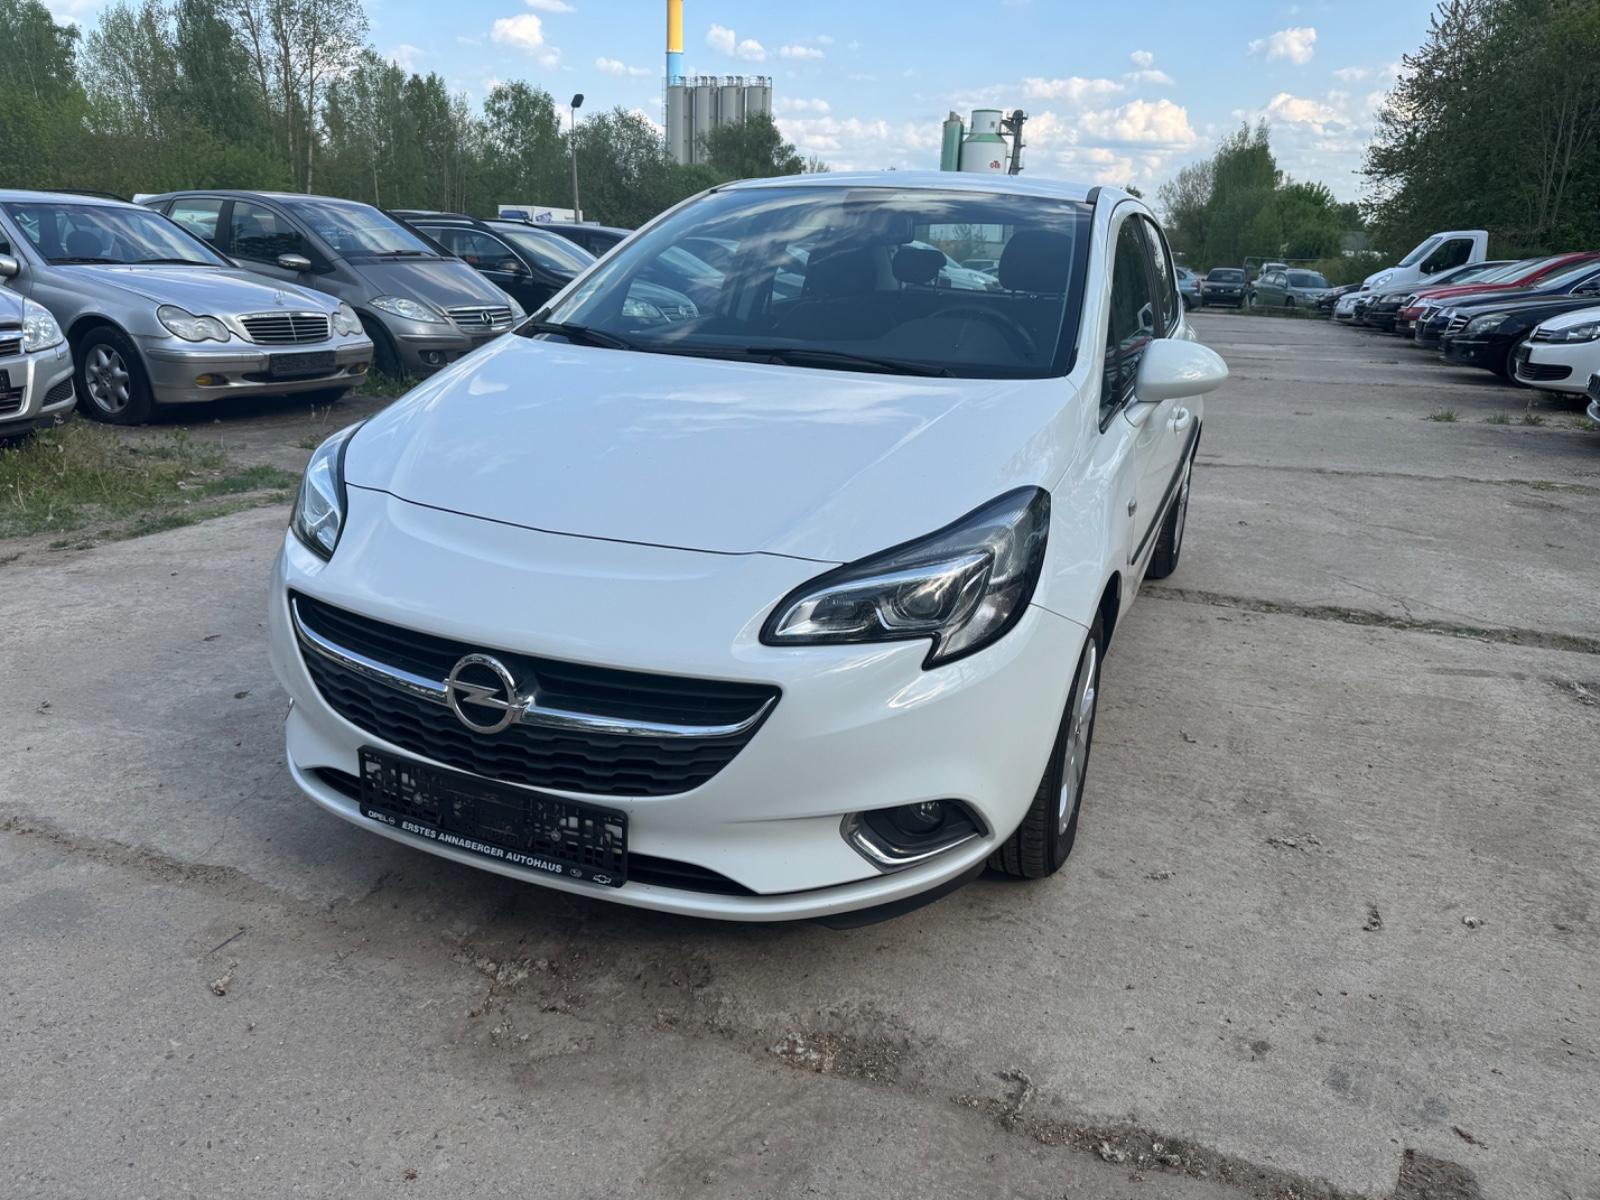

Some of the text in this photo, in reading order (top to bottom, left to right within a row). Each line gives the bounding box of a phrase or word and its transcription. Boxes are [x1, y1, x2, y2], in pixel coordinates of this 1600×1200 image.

[368, 810, 563, 873] OPEL ERSTES ANNABERGER AUTOHAUS
